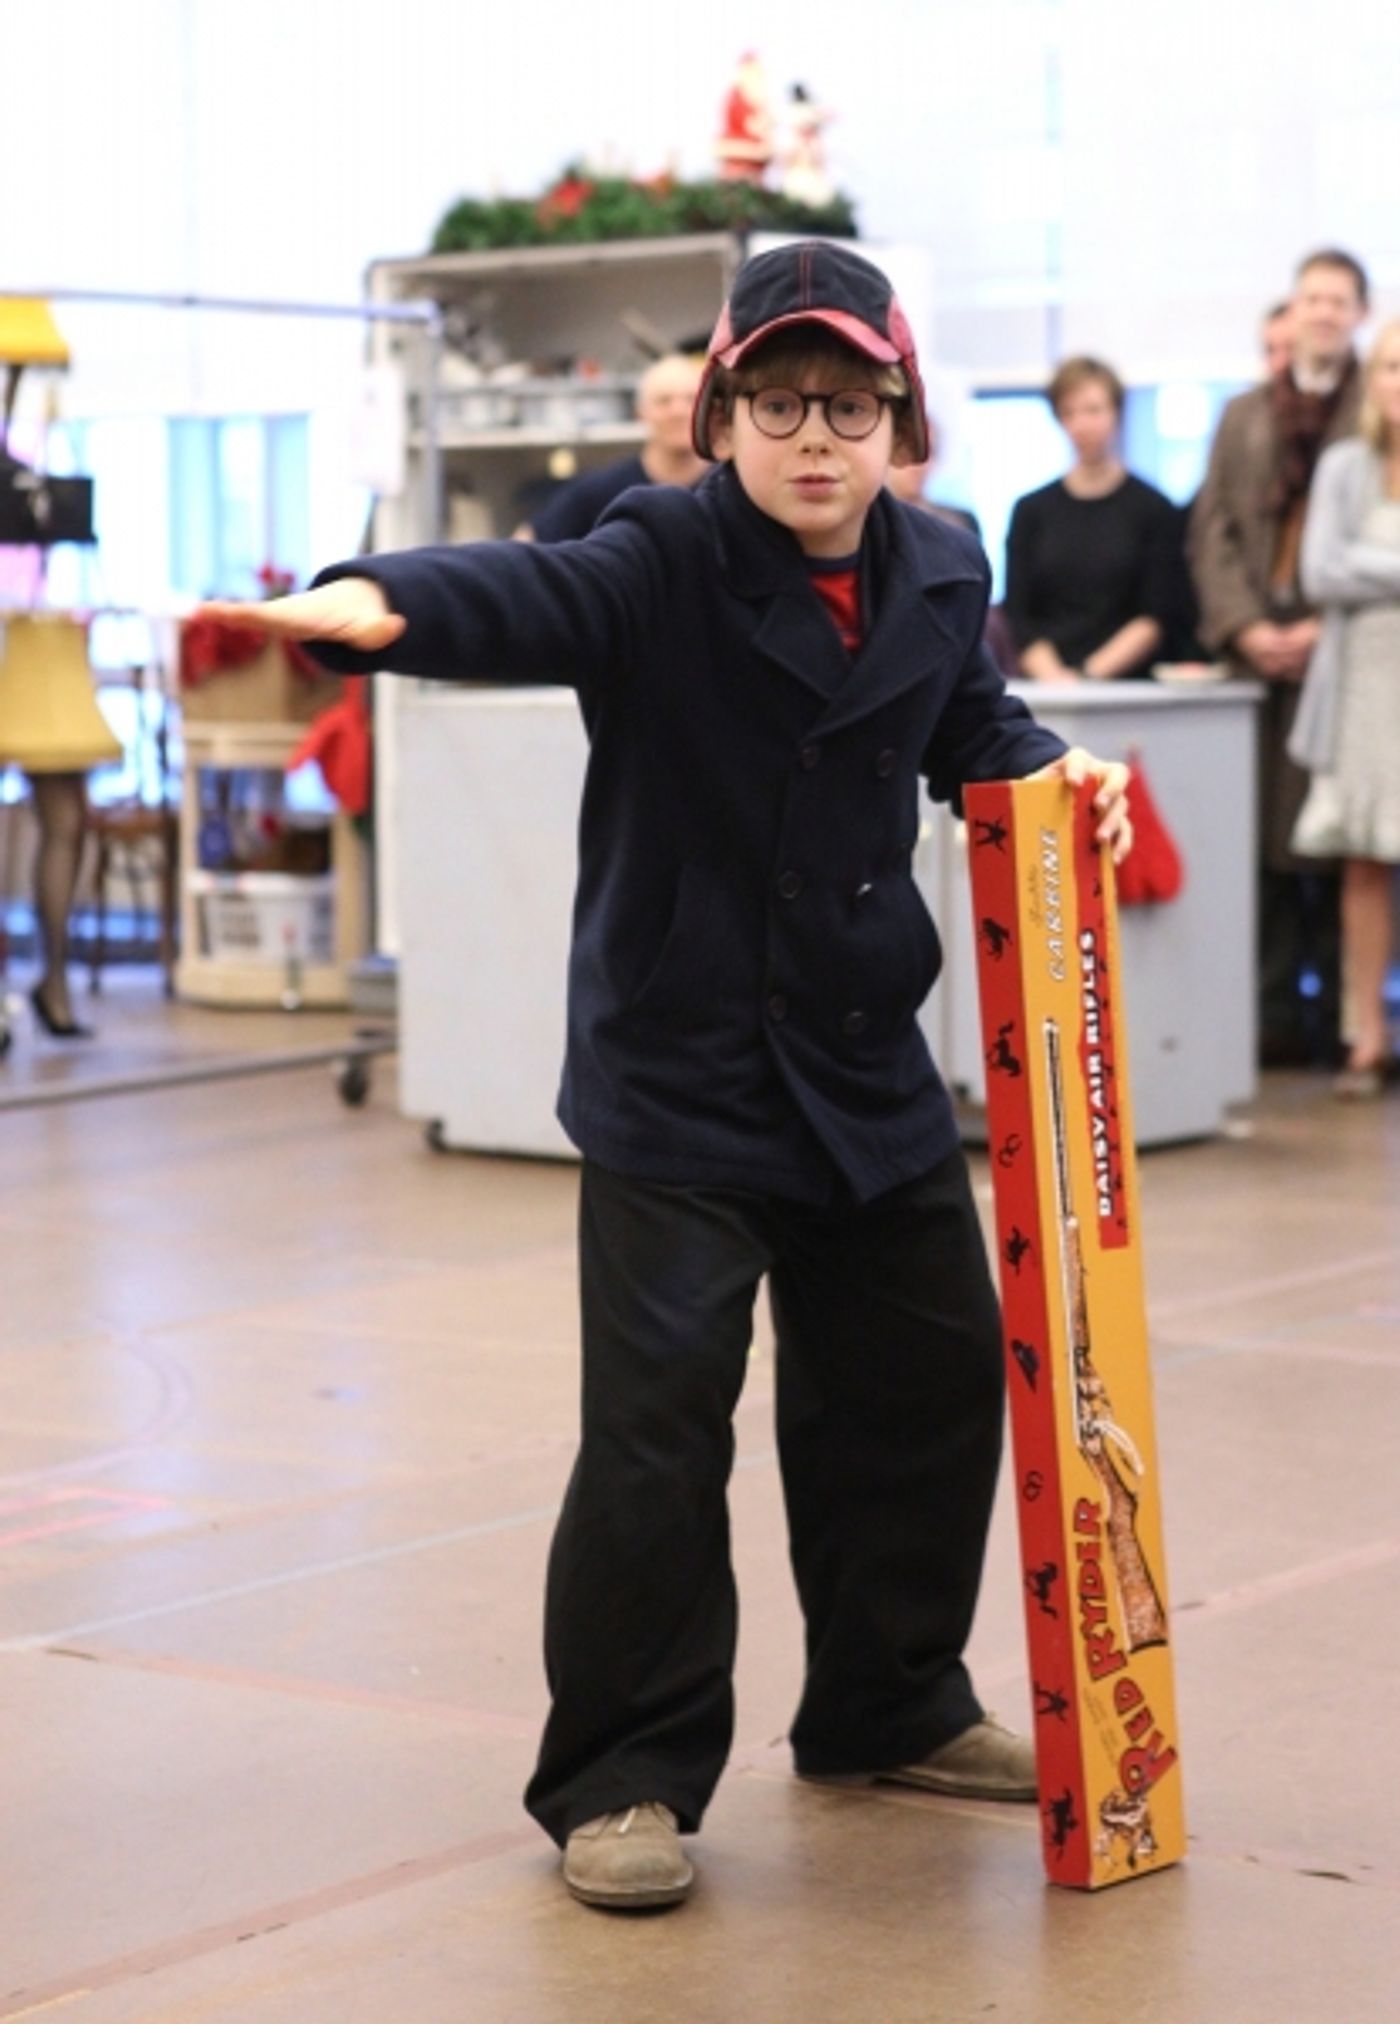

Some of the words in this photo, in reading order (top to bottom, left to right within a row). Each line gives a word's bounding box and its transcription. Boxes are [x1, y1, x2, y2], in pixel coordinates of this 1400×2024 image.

[1041, 828, 1066, 982] CARBINE
[1080, 931, 1101, 1045] RIFLES
[1086, 1054, 1105, 1109] AIR
[1091, 1116, 1112, 1217] DAISY
[1073, 1497, 1128, 1681] RYDER
[1113, 1676, 1178, 1796] RED
